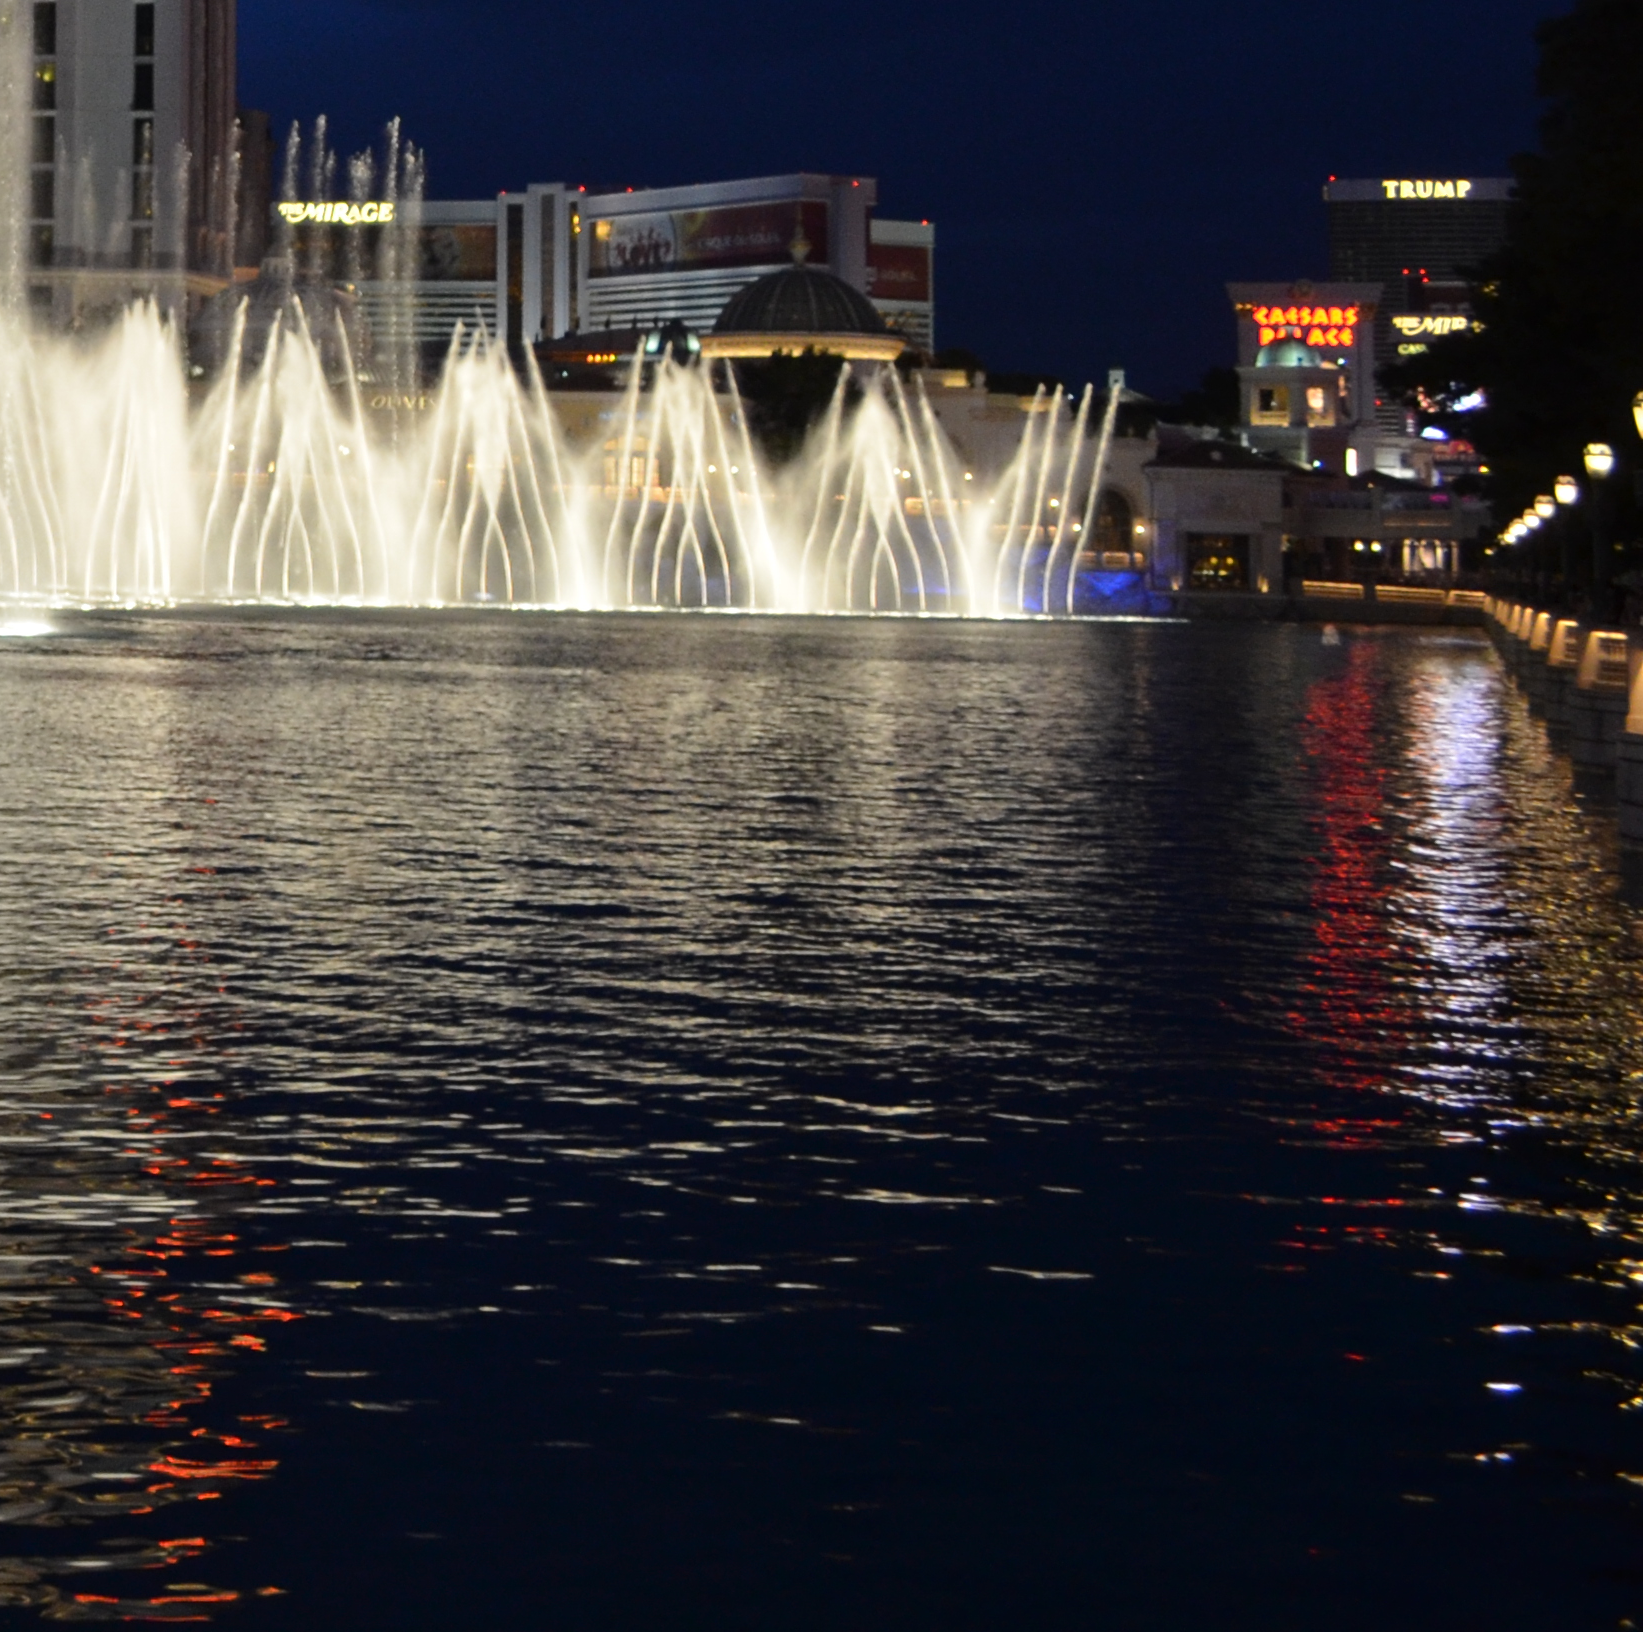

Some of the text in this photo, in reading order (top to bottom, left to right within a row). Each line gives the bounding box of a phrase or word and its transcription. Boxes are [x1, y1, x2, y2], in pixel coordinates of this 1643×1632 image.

[1382, 179, 1472, 199] TRUMP
[285, 202, 394, 225] MIRAGE
[1253, 306, 1358, 327] CAESARS
